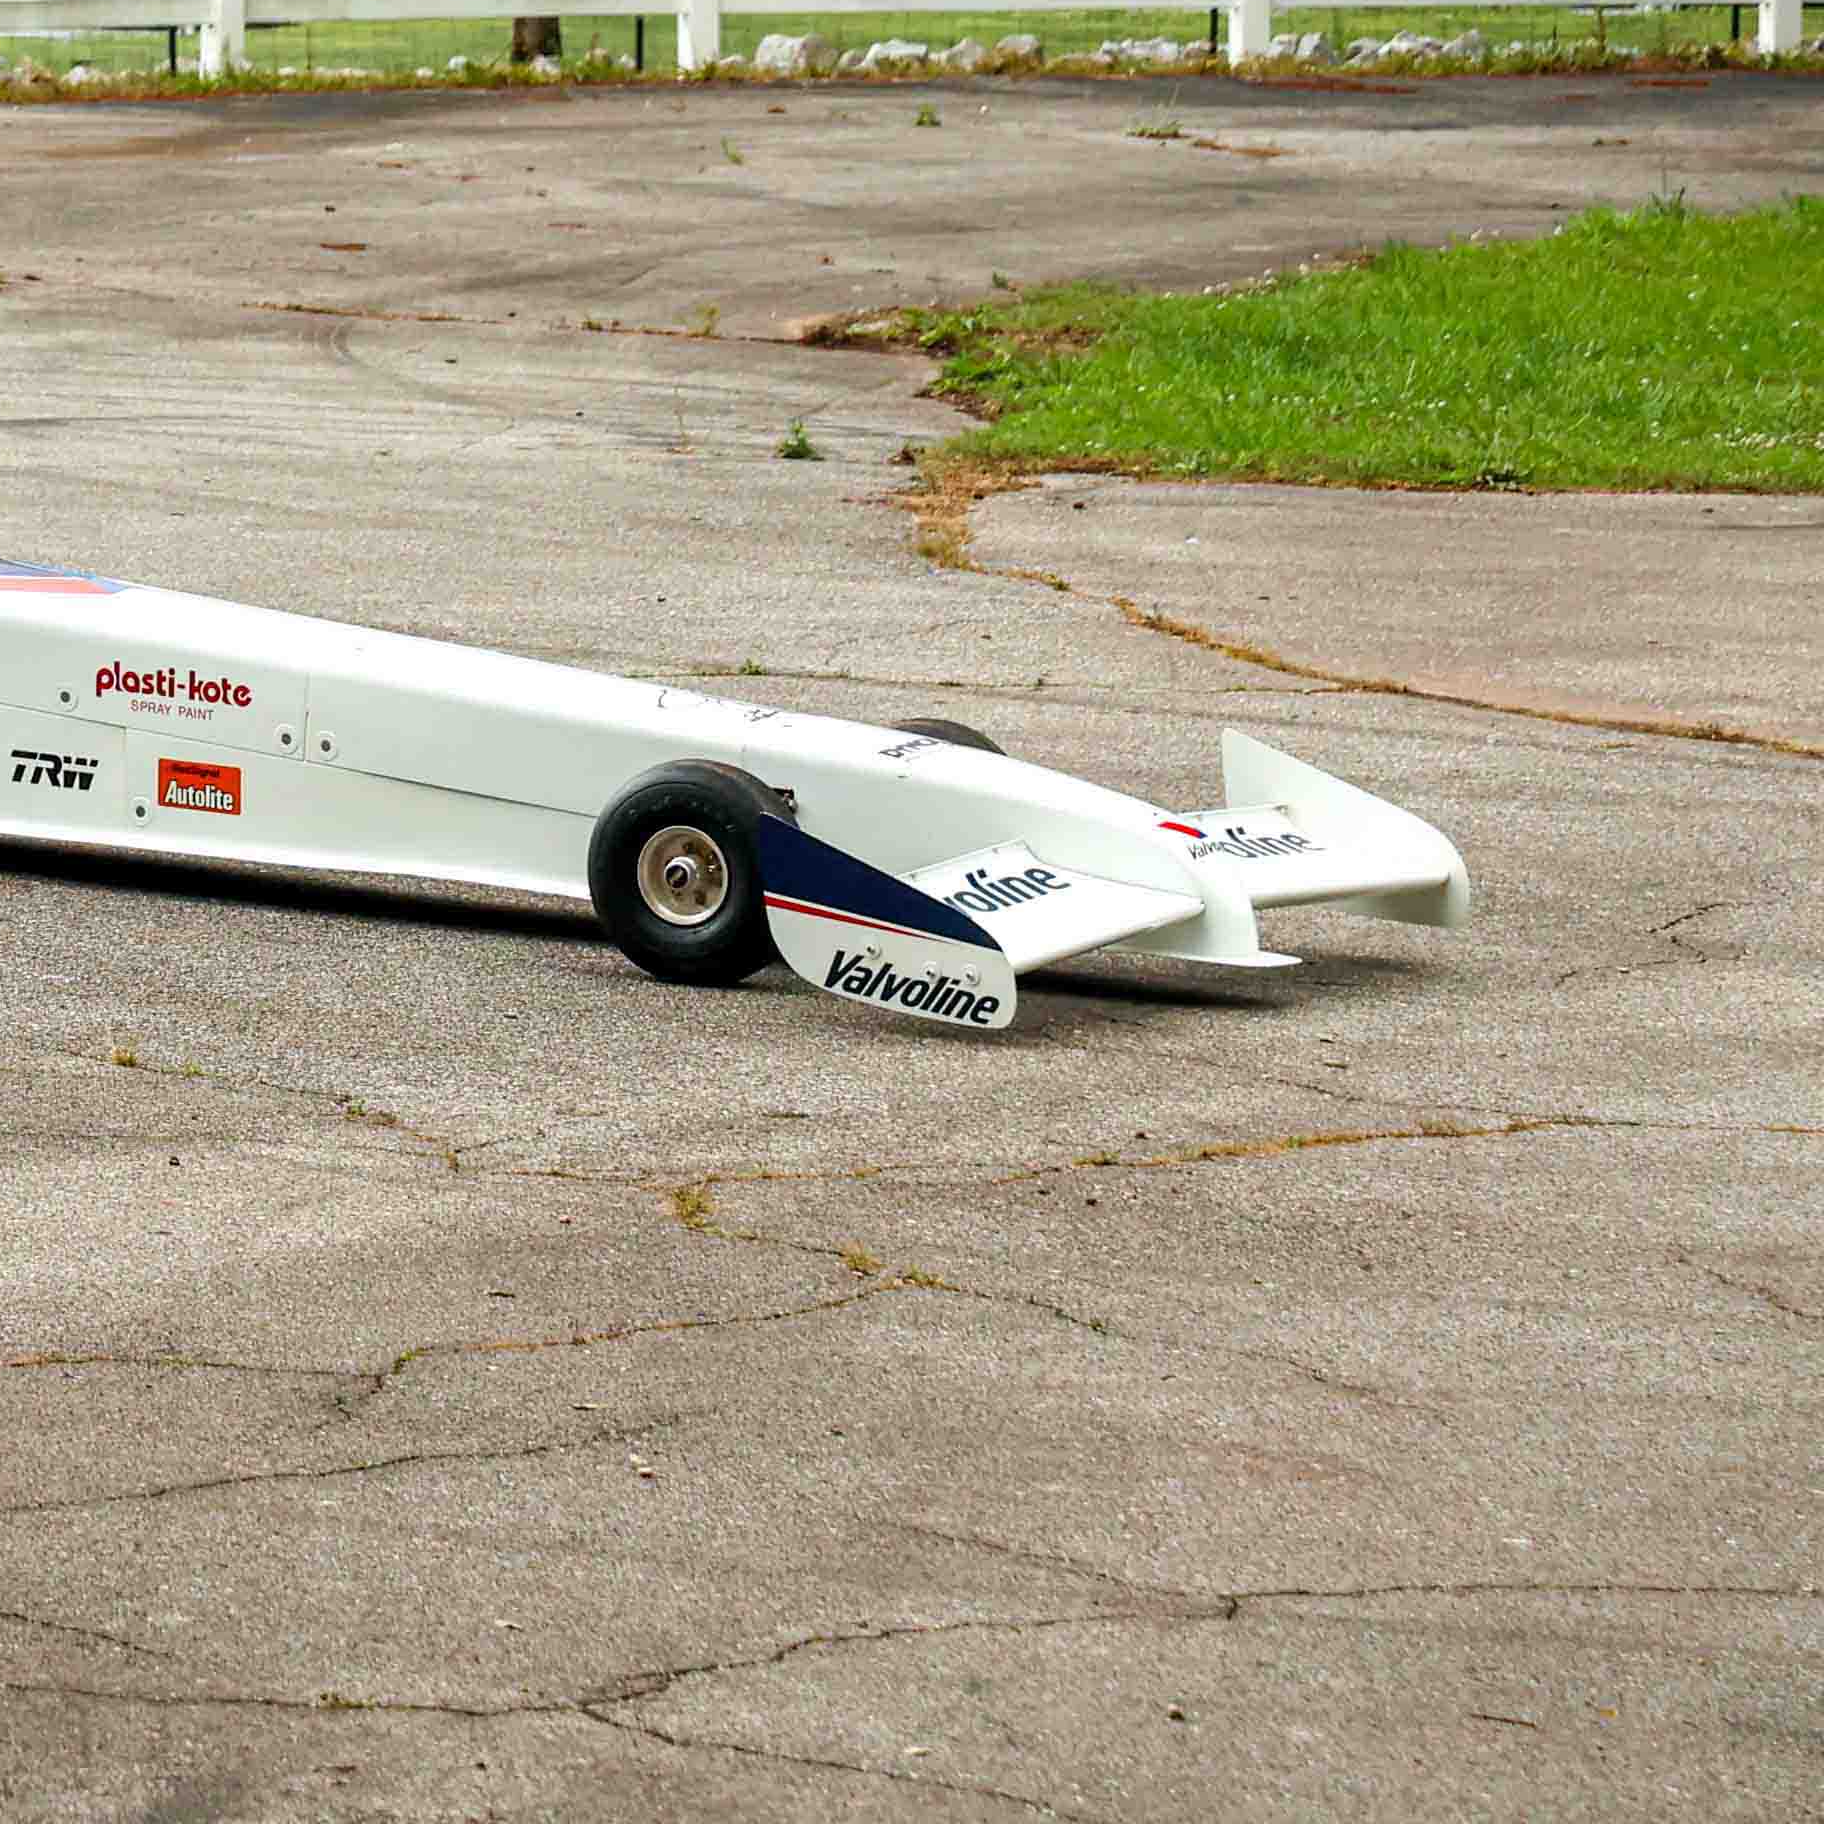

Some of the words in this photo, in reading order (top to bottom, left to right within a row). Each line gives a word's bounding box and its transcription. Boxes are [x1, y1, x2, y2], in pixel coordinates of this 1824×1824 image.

[95, 660, 253, 708] plasti-kote
[130, 699, 173, 716] SPRAY
[177, 705, 215, 721] PAINT
[11, 749, 100, 791] TRW
[164, 778, 234, 812] Autolite
[824, 950, 1000, 1025] Valvoline
